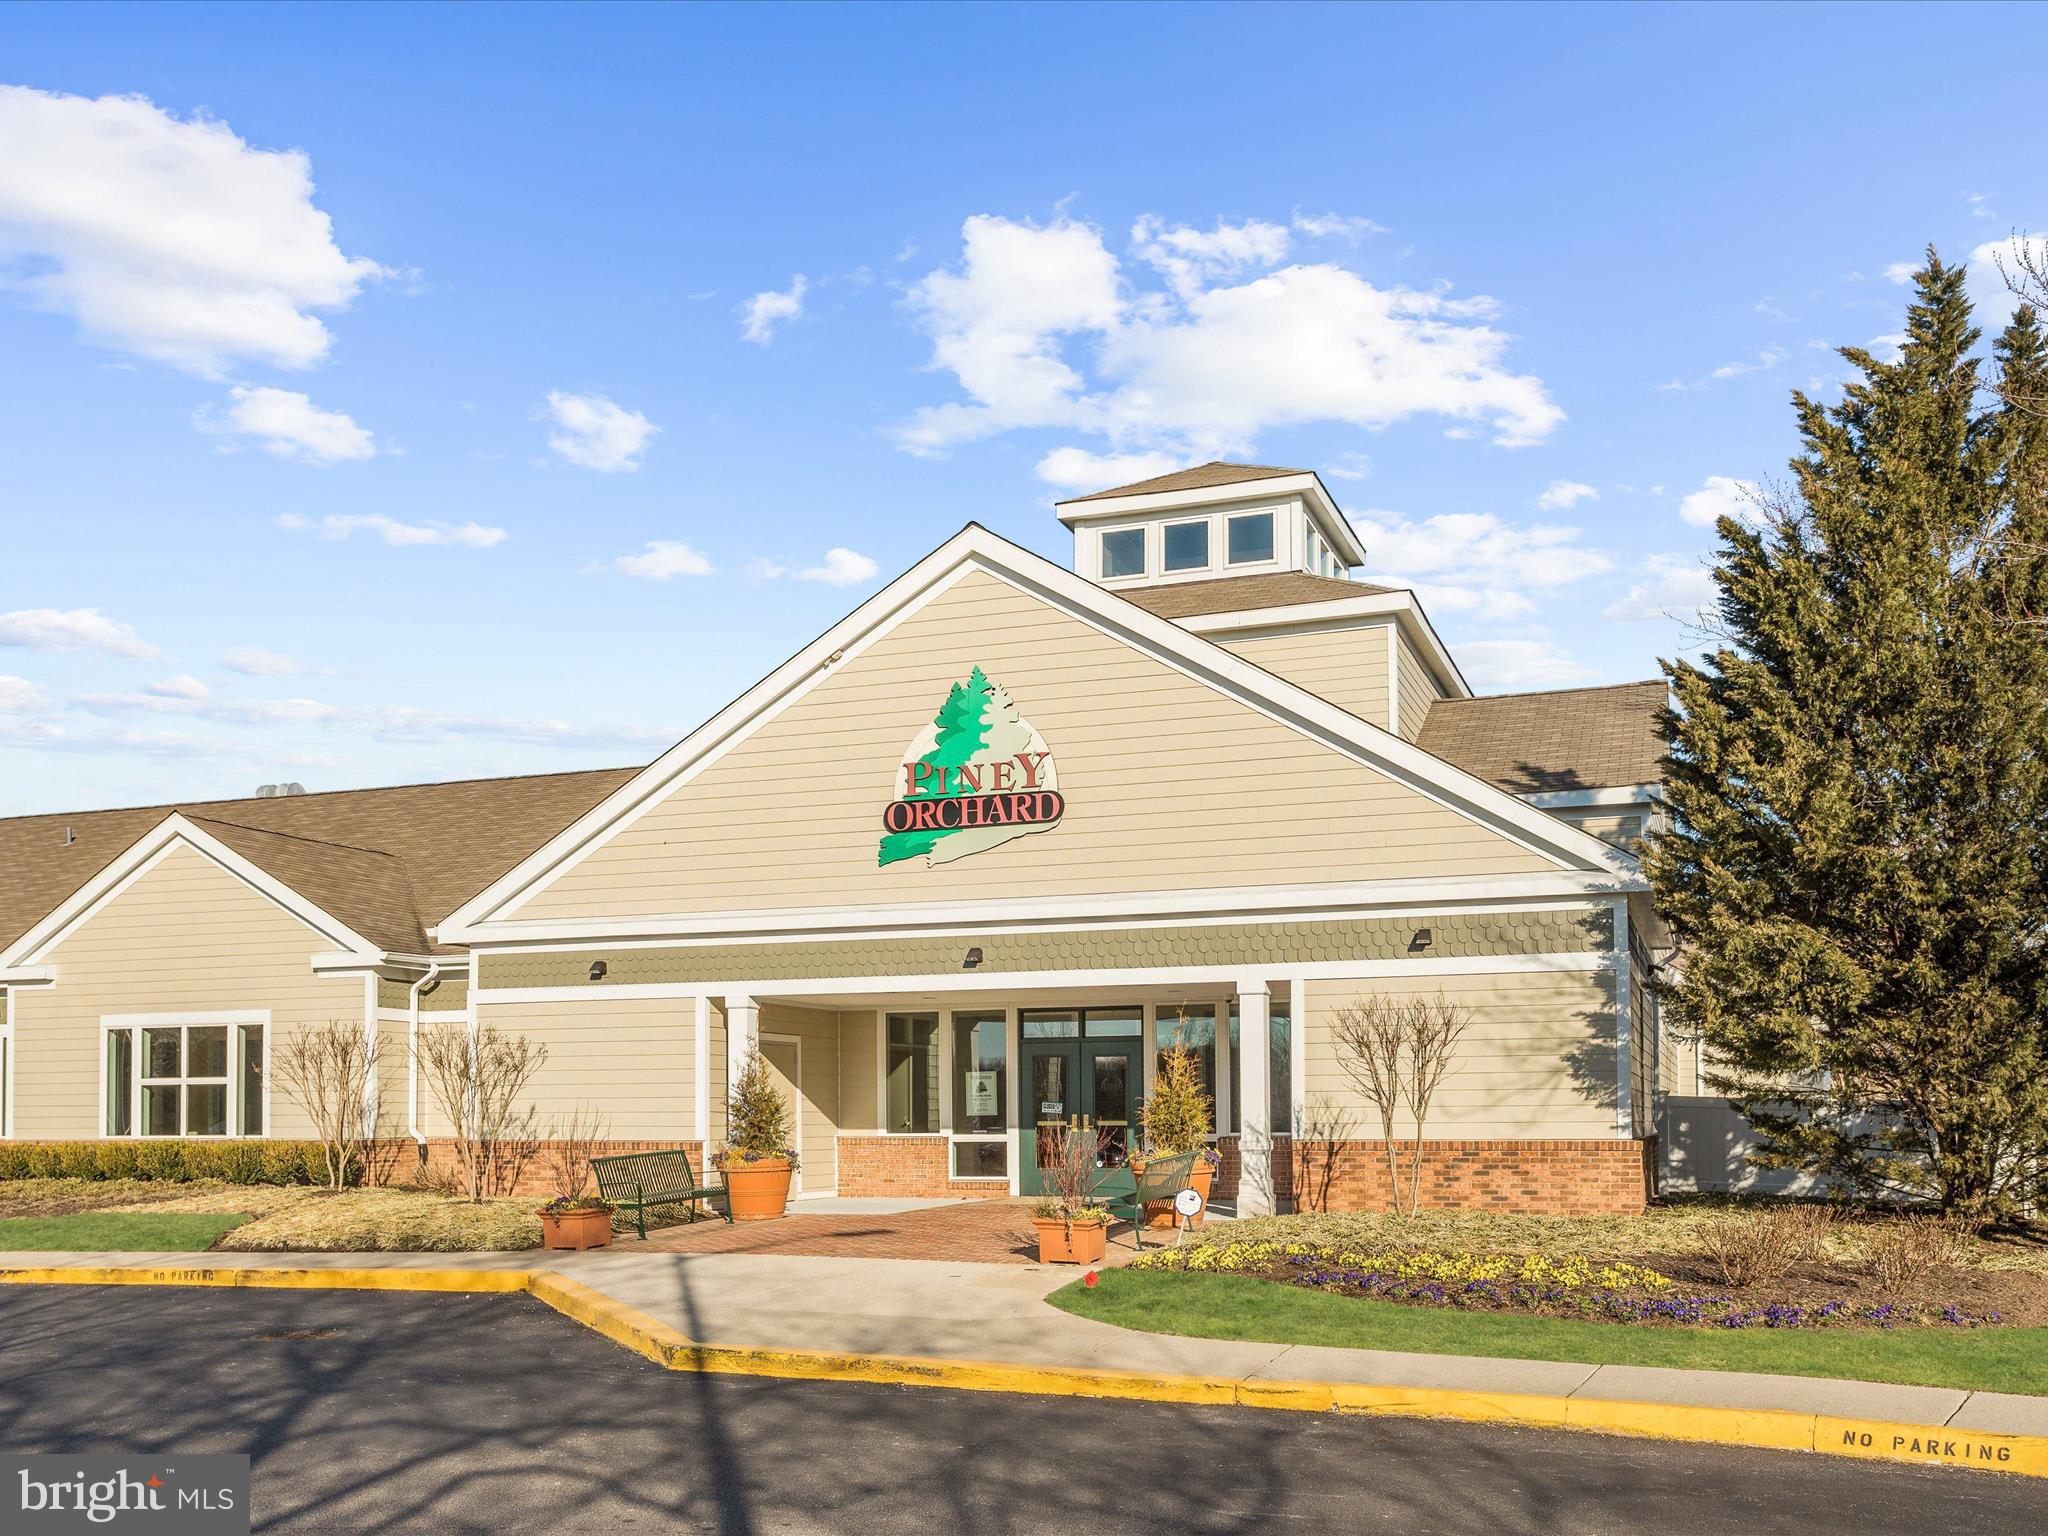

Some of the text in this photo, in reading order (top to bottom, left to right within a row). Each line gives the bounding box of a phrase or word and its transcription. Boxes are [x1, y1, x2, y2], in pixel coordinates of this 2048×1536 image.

[902, 751, 1050, 797] PINEY
[886, 792, 1061, 832] ORCHARD
[153, 1270, 214, 1281] NO PARKING
[1842, 1430, 2011, 1462] NO PARKING
